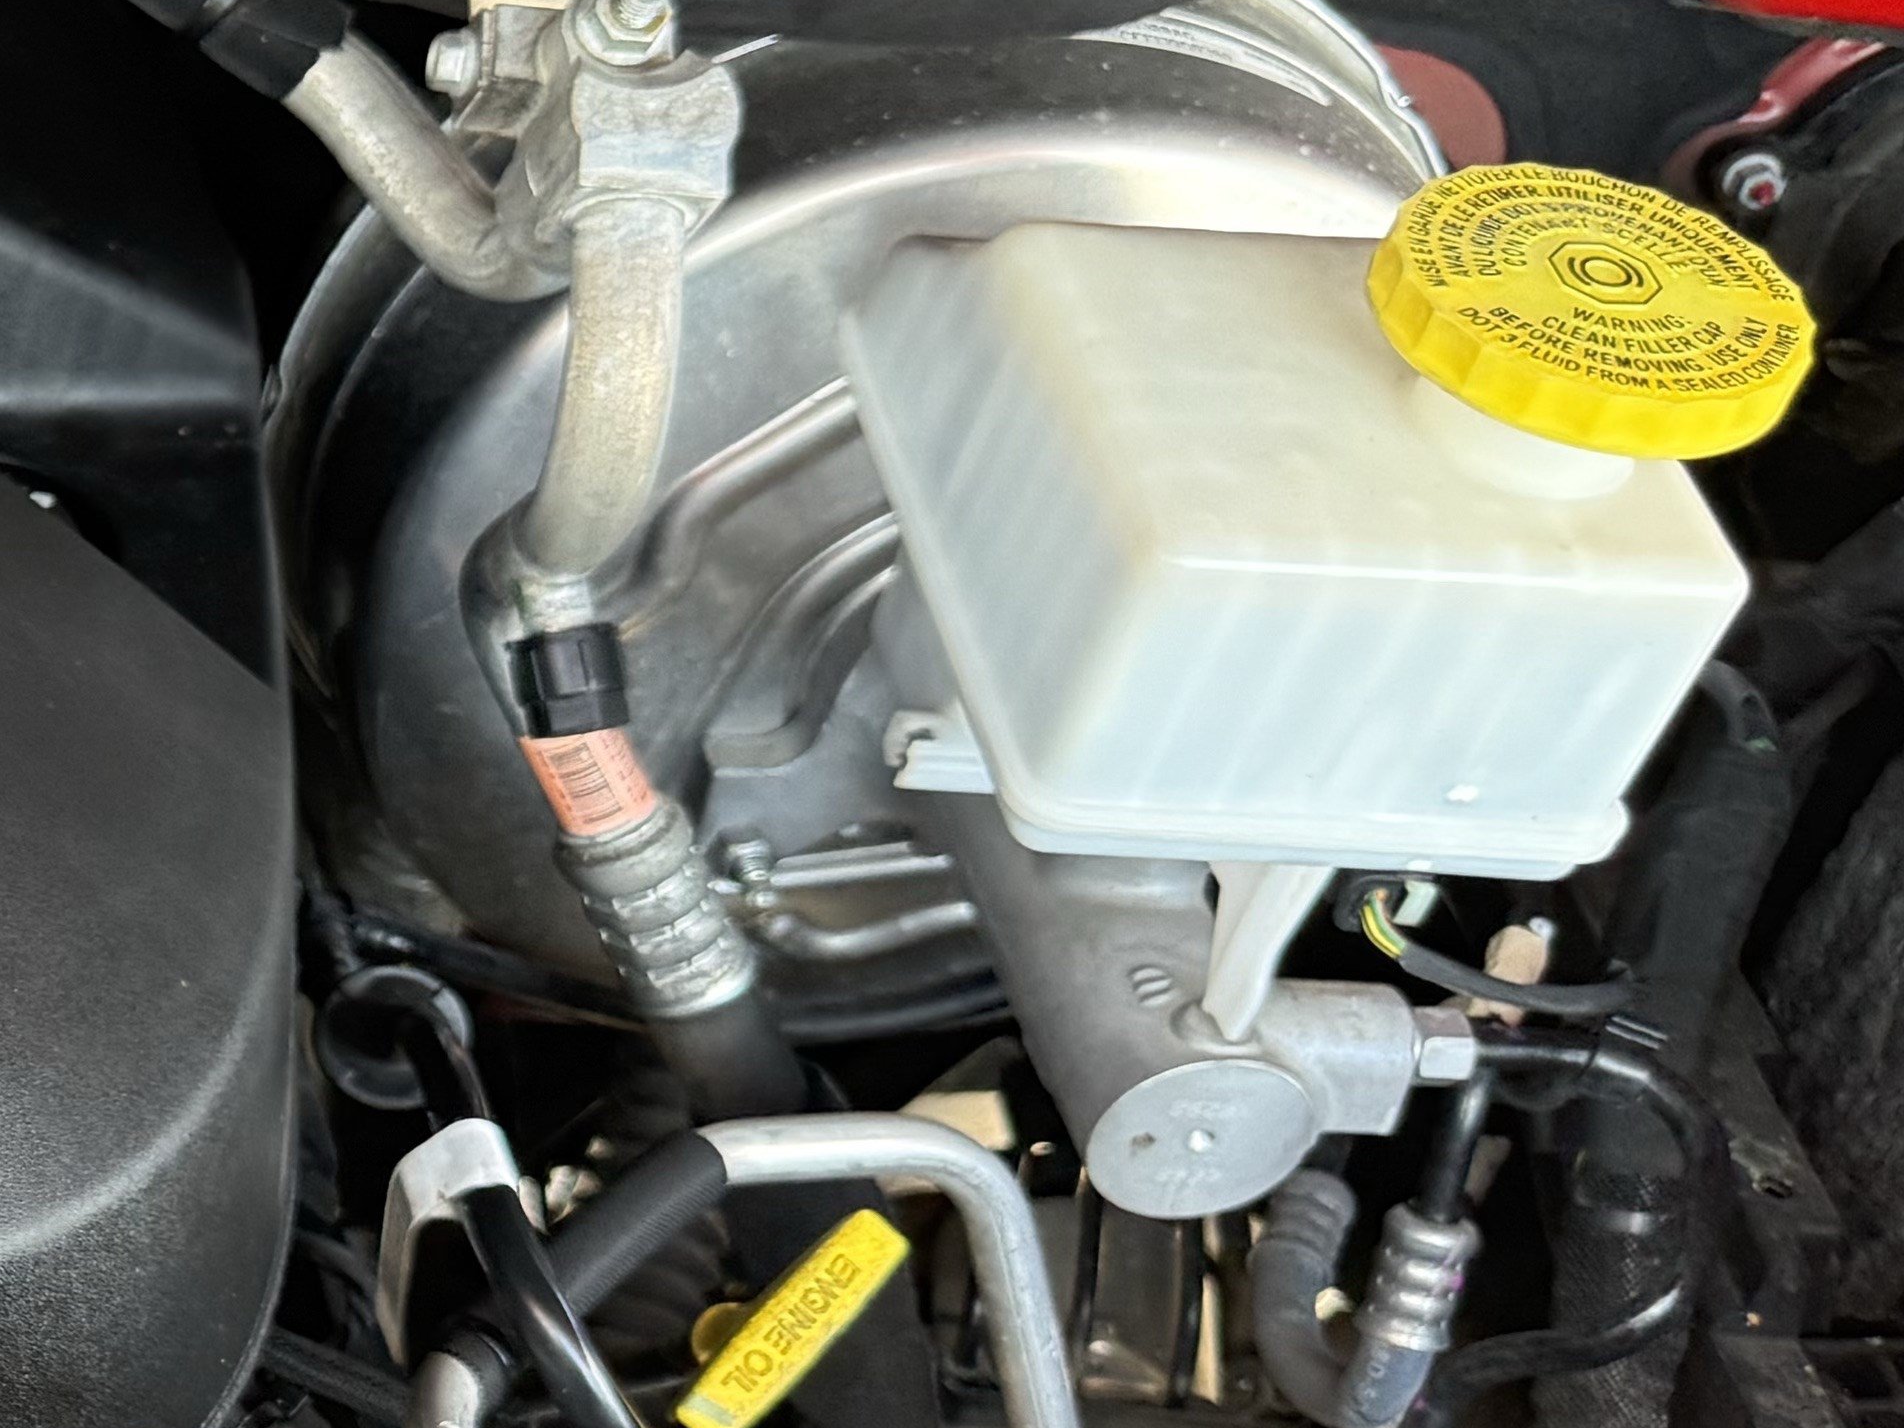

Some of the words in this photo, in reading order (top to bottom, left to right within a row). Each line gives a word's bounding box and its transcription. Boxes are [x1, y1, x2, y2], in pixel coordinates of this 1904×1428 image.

[1447, 204, 1476, 223] LE
[1546, 184, 1645, 216] UTILISER
[1409, 236, 1434, 255] EN
[1435, 168, 1520, 201] NETTOYER
[1519, 168, 1546, 181] LE
[1551, 170, 1656, 203] BOUCHON
[1660, 198, 1687, 218] DE
[1692, 214, 1795, 303] REMPLISSAGE
[1440, 218, 1466, 238] DE
[1469, 213, 1508, 257] LIQUIDE
[1438, 235, 1472, 278] AVANT
[1648, 210, 1761, 291] UNIQUEMENT
[1488, 306, 1576, 355] BEFORE
[1705, 343, 1749, 367] USE
[1734, 315, 1769, 349] ONLY
[1541, 315, 1616, 349] CLEAN
[1624, 335, 1699, 355] FILLER
[1691, 320, 1726, 345] CAP
[1572, 306, 1692, 333] WARNING:
[1456, 306, 1504, 333] DOT
[1499, 333, 1520, 344] 3
[1516, 340, 1582, 372] FLUID
[1585, 365, 1651, 389] FROM
[1655, 379, 1672, 392] A
[1672, 370, 1749, 392] SEALED
[1741, 323, 1800, 380] CONTAINER
[763, 1253, 861, 1357] ENGINE
[719, 1348, 774, 1394] OIL
